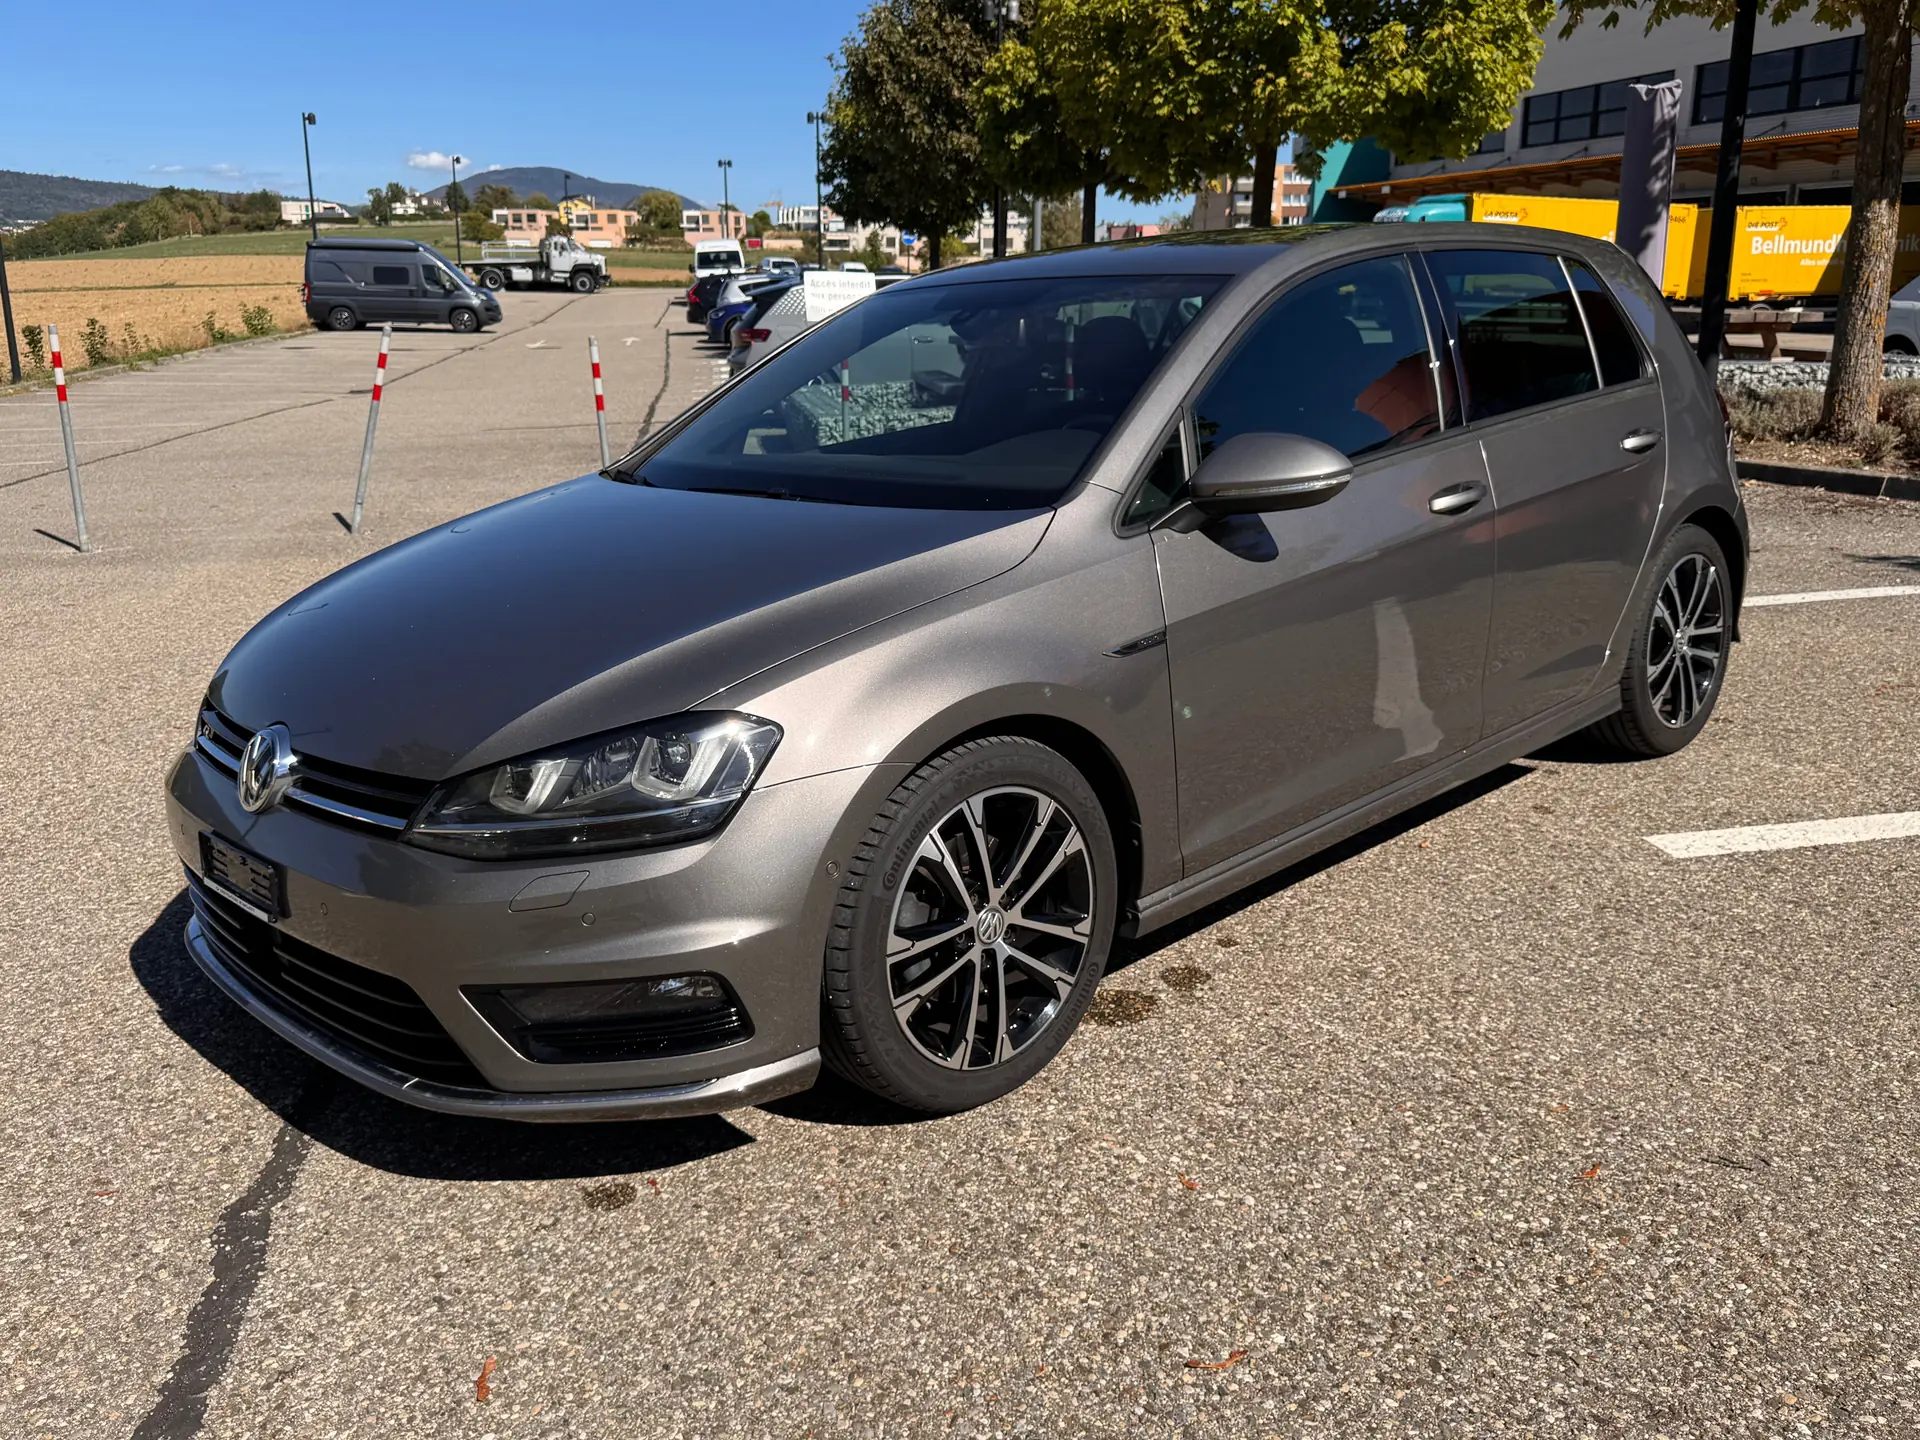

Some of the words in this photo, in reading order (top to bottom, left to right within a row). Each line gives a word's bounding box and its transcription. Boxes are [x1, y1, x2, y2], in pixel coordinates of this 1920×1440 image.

[1760, 221, 1779, 229] POST
[838, 279, 871, 289] interdit
[882, 799, 942, 892] Continental
